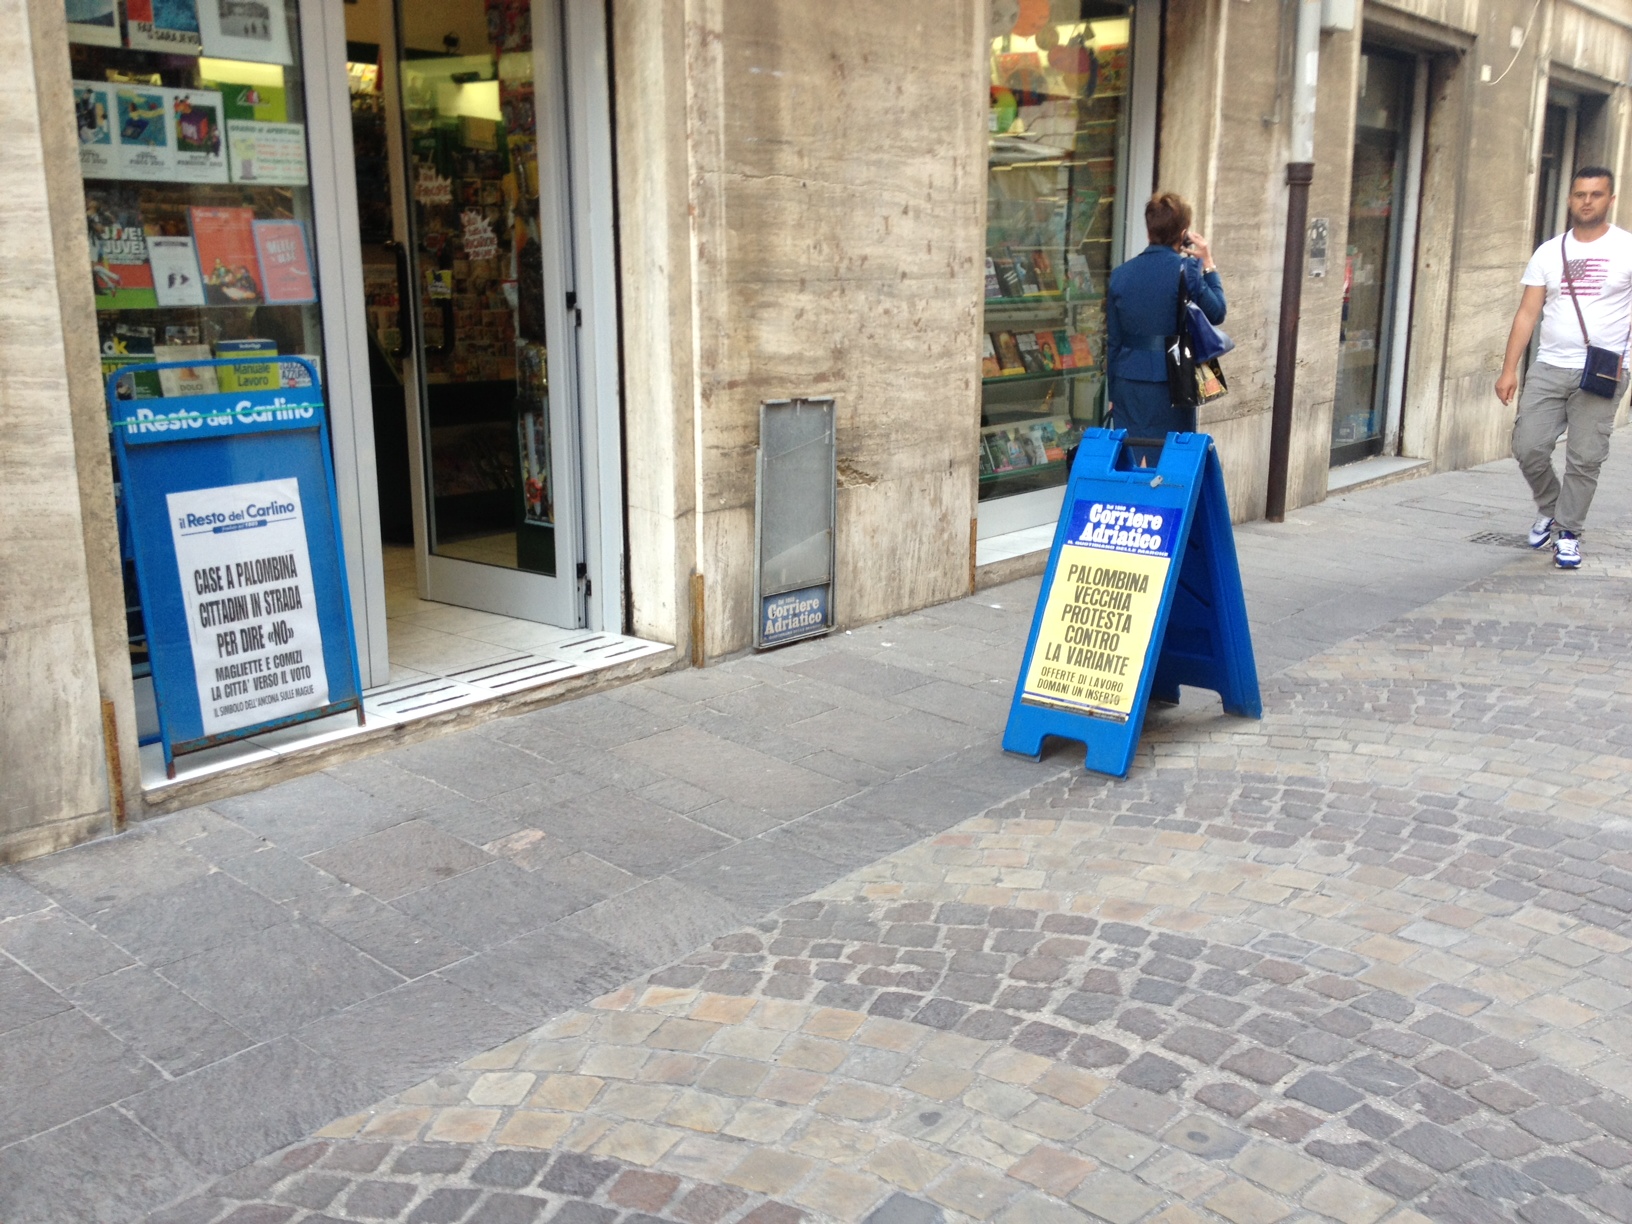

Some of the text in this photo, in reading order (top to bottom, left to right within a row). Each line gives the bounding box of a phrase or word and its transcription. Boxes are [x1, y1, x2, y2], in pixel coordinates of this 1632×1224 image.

[237, 375, 268, 387] Lavoro
[137, 408, 204, 432] Resto
[207, 409, 233, 426] del
[236, 398, 314, 423] Carlino
[179, 518, 186, 529] il
[187, 512, 226, 528] Resto
[229, 510, 244, 522] del
[246, 501, 294, 518] Carlino
[1090, 504, 1163, 530] Corriere
[1079, 522, 1162, 550] Adriatico
[194, 554, 297, 595] CASE A PALOMBINA
[1067, 564, 1149, 593] PALOMBINA
[200, 586, 302, 628] CITTADINI IN STRADA
[768, 598, 819, 619] Corriere
[1075, 585, 1132, 612] VECCHIA
[765, 612, 822, 634] Adriatico
[1061, 604, 1132, 633] PROTESTA
[217, 620, 294, 658] PER DIRE «NO»
[1064, 625, 1120, 652] CONTRO
[215, 650, 302, 682] MAGLIETTE E COMIZI
[1045, 642, 1130, 676] LA VARIANTE
[211, 665, 311, 701] LA CITTA' VERSO IL VOTO
[1037, 678, 1120, 706] DOMANI UN INSERTO
[1041, 666, 1123, 692] OFFERTE DI LAVORO
[214, 684, 314, 718] IL SIMBOLO DELL'ANCONA SULLE MAGLIE
